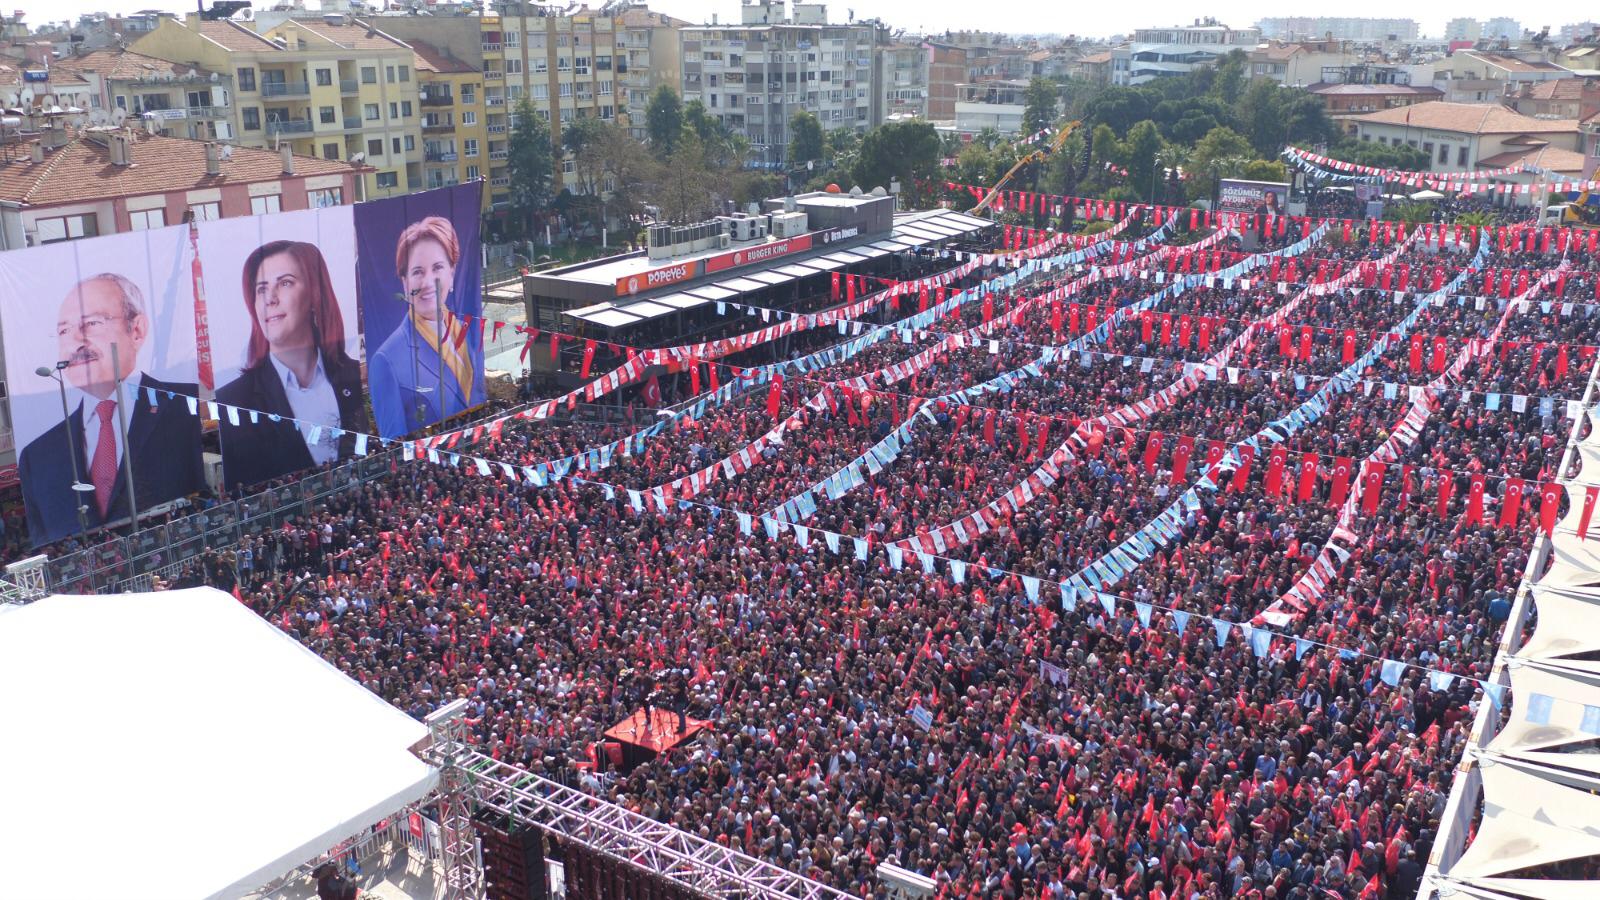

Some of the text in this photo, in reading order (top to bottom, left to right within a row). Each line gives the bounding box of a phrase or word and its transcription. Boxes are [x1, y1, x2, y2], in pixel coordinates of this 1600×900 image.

[1223, 186, 1261, 197] SÖZÜMÜZ
[747, 243, 788, 261] BURGER KING
